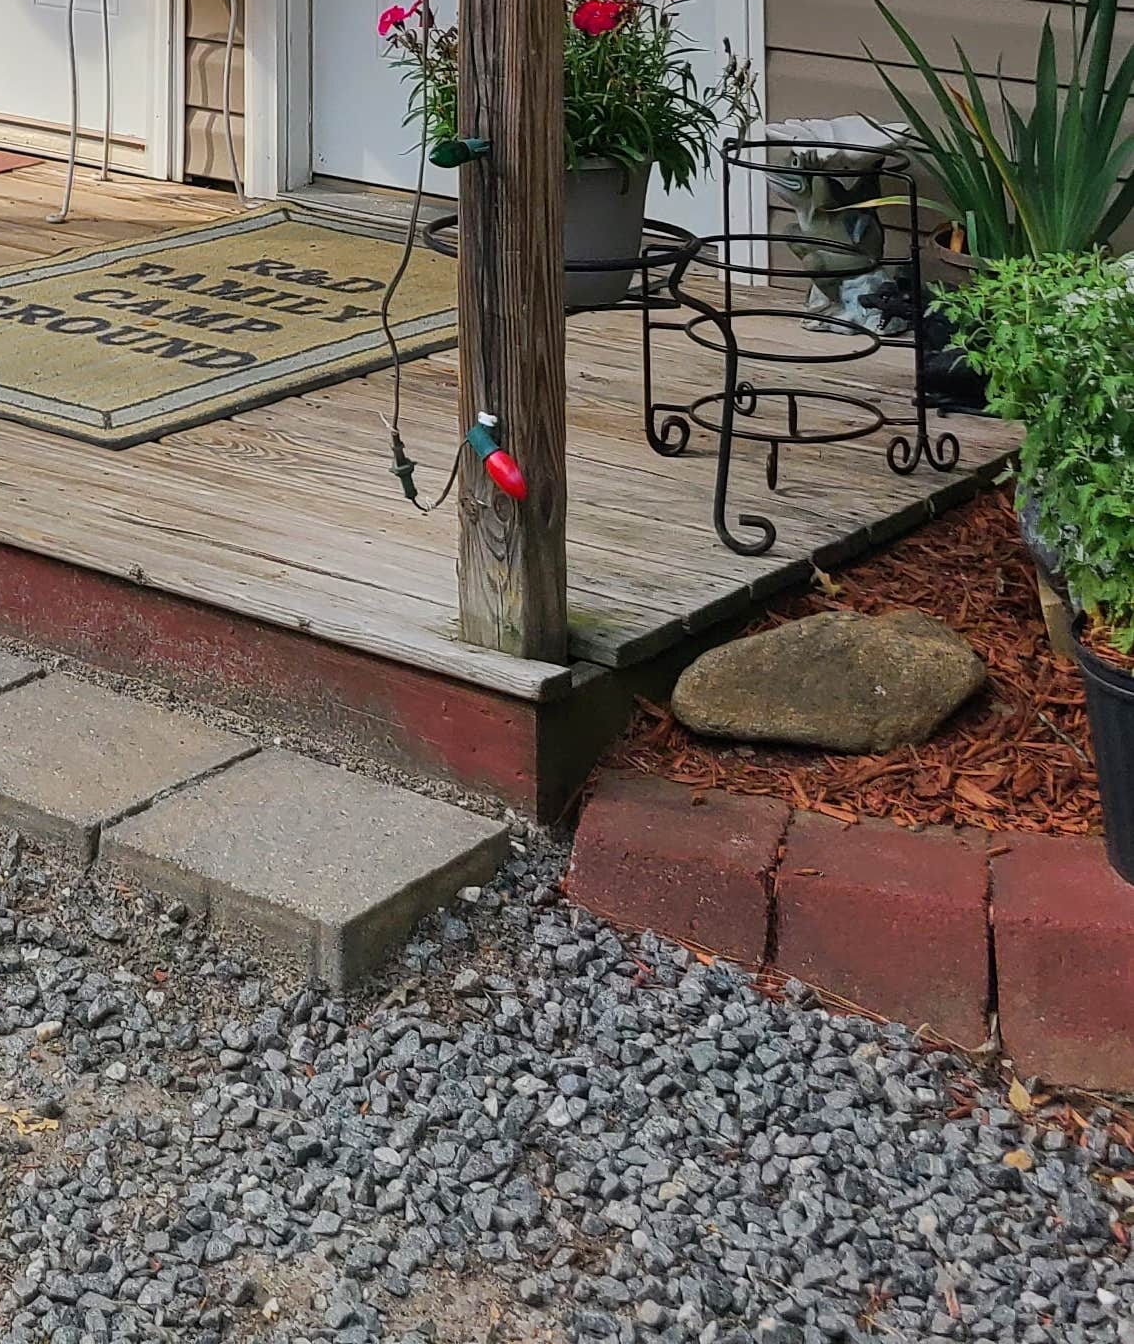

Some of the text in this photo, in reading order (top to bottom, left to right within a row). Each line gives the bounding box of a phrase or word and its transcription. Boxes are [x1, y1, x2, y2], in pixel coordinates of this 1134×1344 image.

[106, 262, 389, 323] FAMILY
[228, 258, 386, 294] R&D
[73, 288, 283, 335] CAMP
